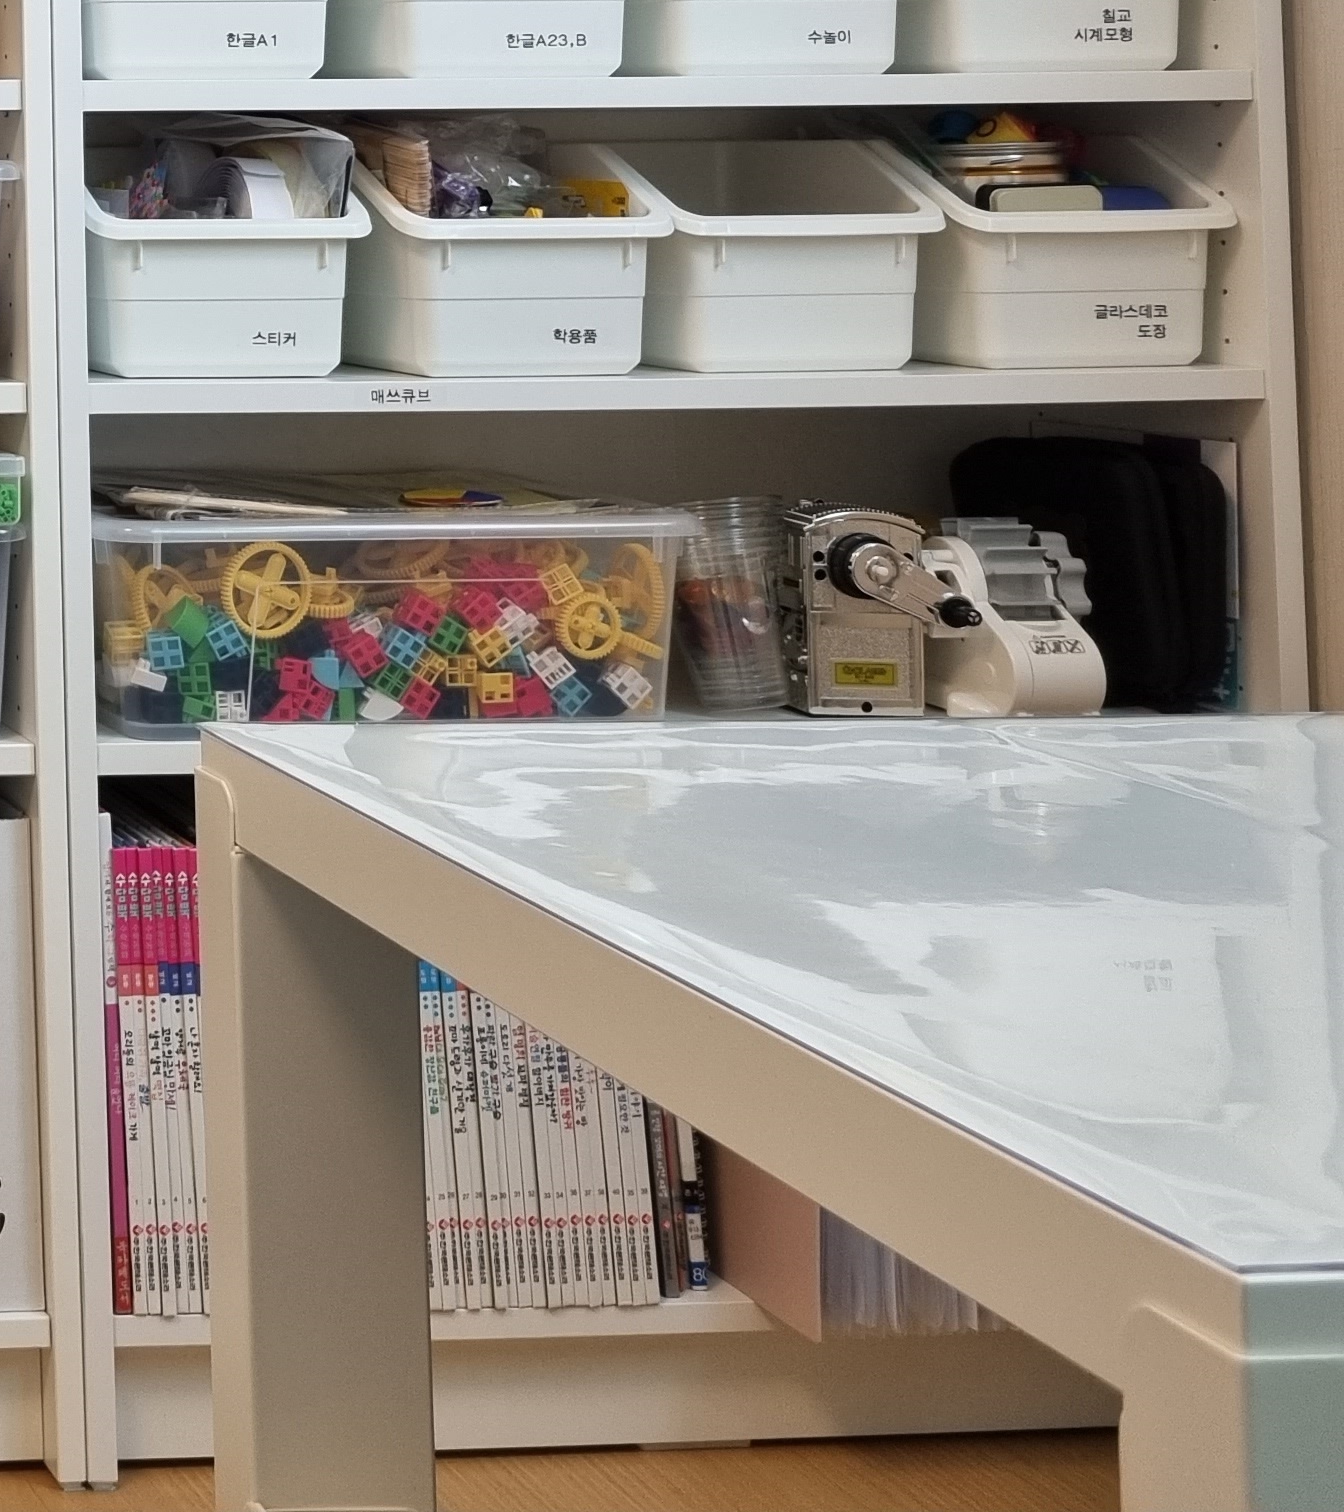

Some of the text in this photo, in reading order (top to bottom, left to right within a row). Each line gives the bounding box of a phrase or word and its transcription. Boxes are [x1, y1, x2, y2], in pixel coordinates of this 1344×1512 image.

[1102, 7, 1132, 24] 칠교
[505, 33, 588, 50] 한글A23,B
[807, 29, 852, 46] 수놀이
[1074, 27, 1134, 44] 시계모형
[1094, 303, 1168, 320] 글라스데코
[252, 331, 297, 347] 스티커
[553, 328, 598, 346] 학용품
[1137, 323, 1167, 340] 도장
[370, 389, 431, 404] 매쓰큐브
